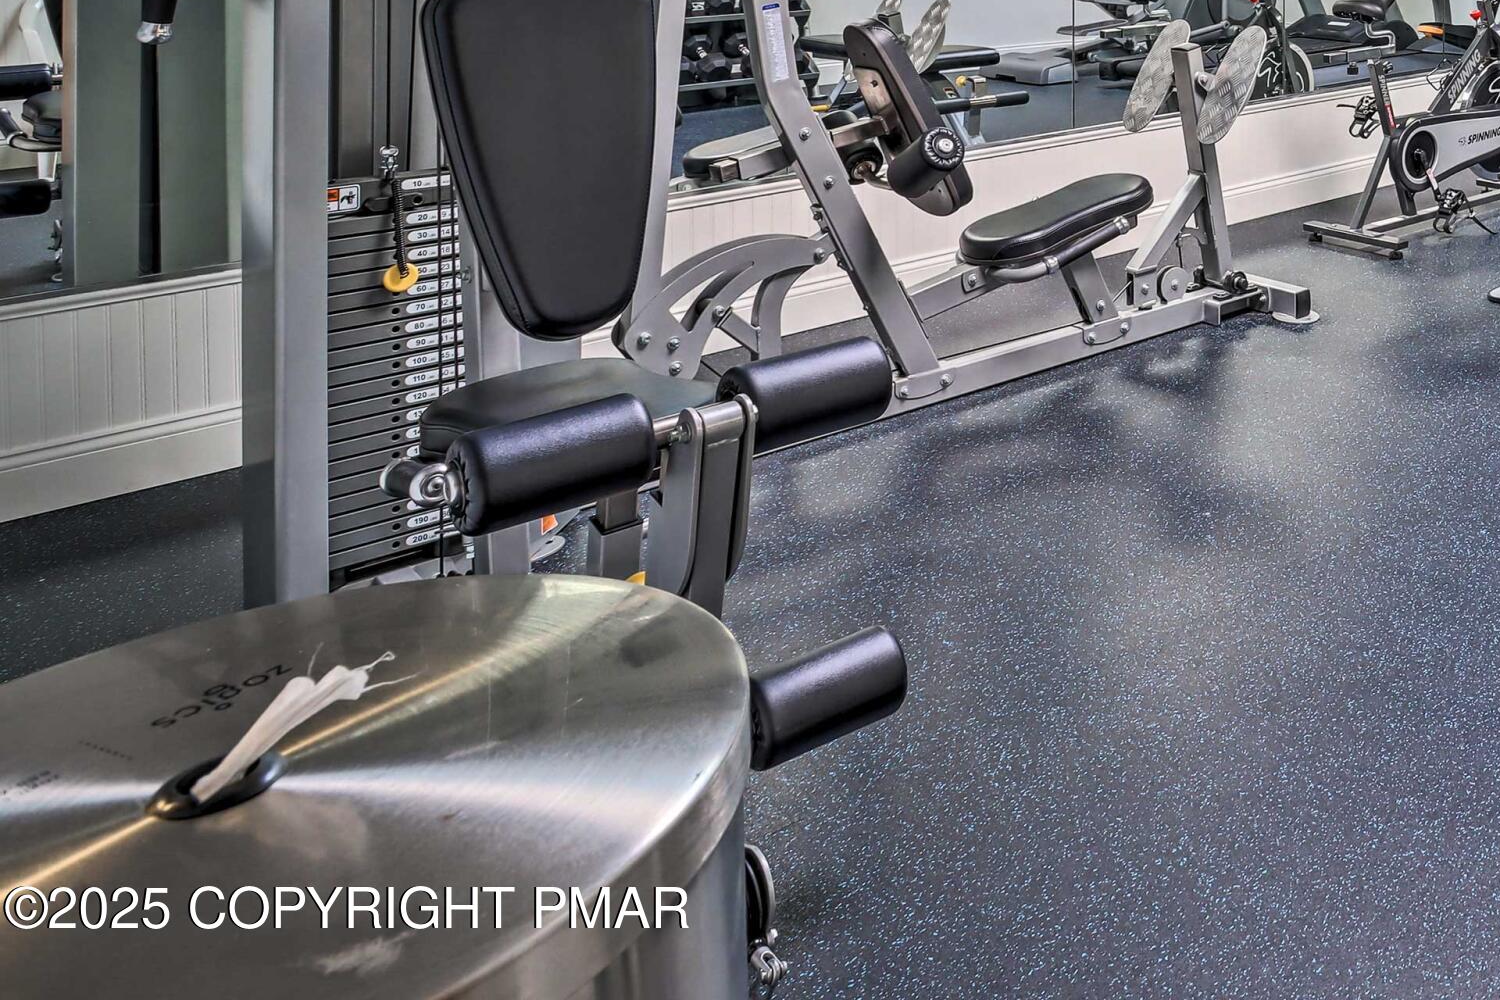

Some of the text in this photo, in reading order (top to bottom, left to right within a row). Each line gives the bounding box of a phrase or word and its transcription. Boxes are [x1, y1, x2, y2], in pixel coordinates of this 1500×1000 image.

[1447, 49, 1482, 102] SPINNING
[414, 516, 428, 524] 190
[412, 534, 428, 543] 200
[150, 663, 293, 729] zogics
